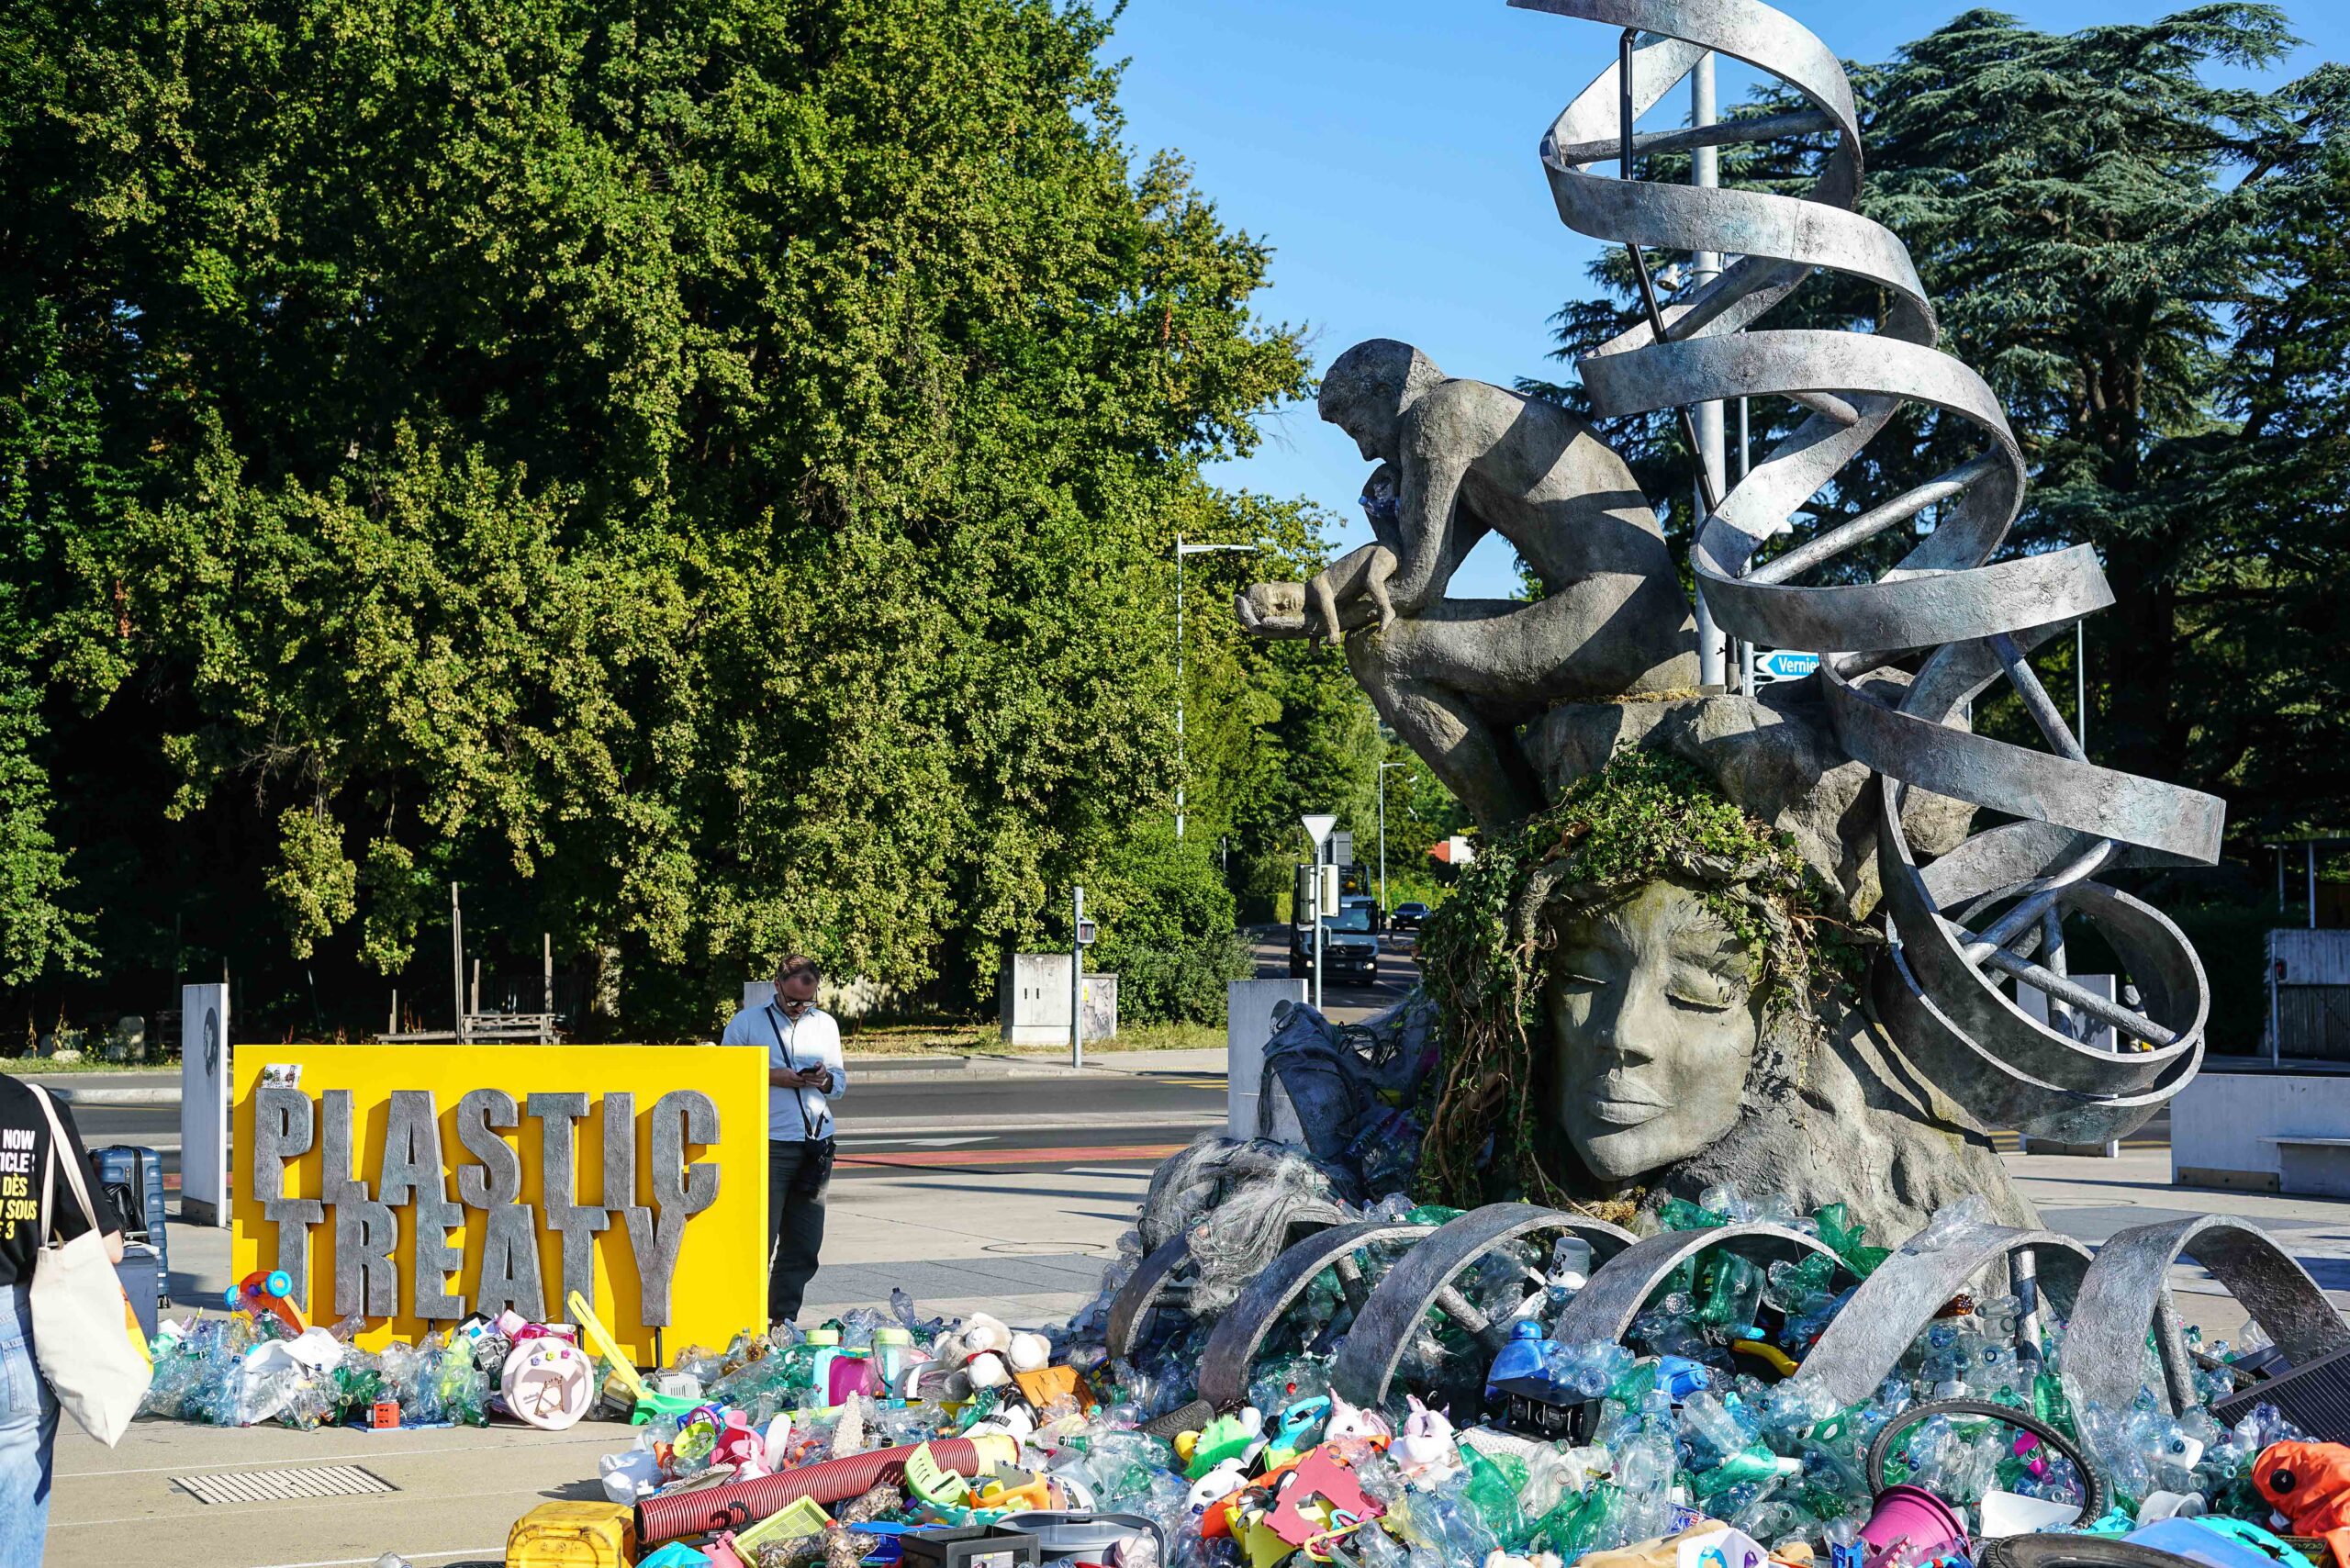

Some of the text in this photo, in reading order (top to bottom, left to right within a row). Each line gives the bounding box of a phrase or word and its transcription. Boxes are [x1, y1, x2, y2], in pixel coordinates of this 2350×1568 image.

[2, 1128, 36, 1151] NOW
[253, 1088, 722, 1214] PLASTIC
[0, 1151, 30, 1173] ICLE
[2, 1173, 28, 1197] DÈS
[5, 1199, 38, 1221] SOUS
[5, 1220, 16, 1240] 3
[263, 1198, 688, 1327] TREATY
